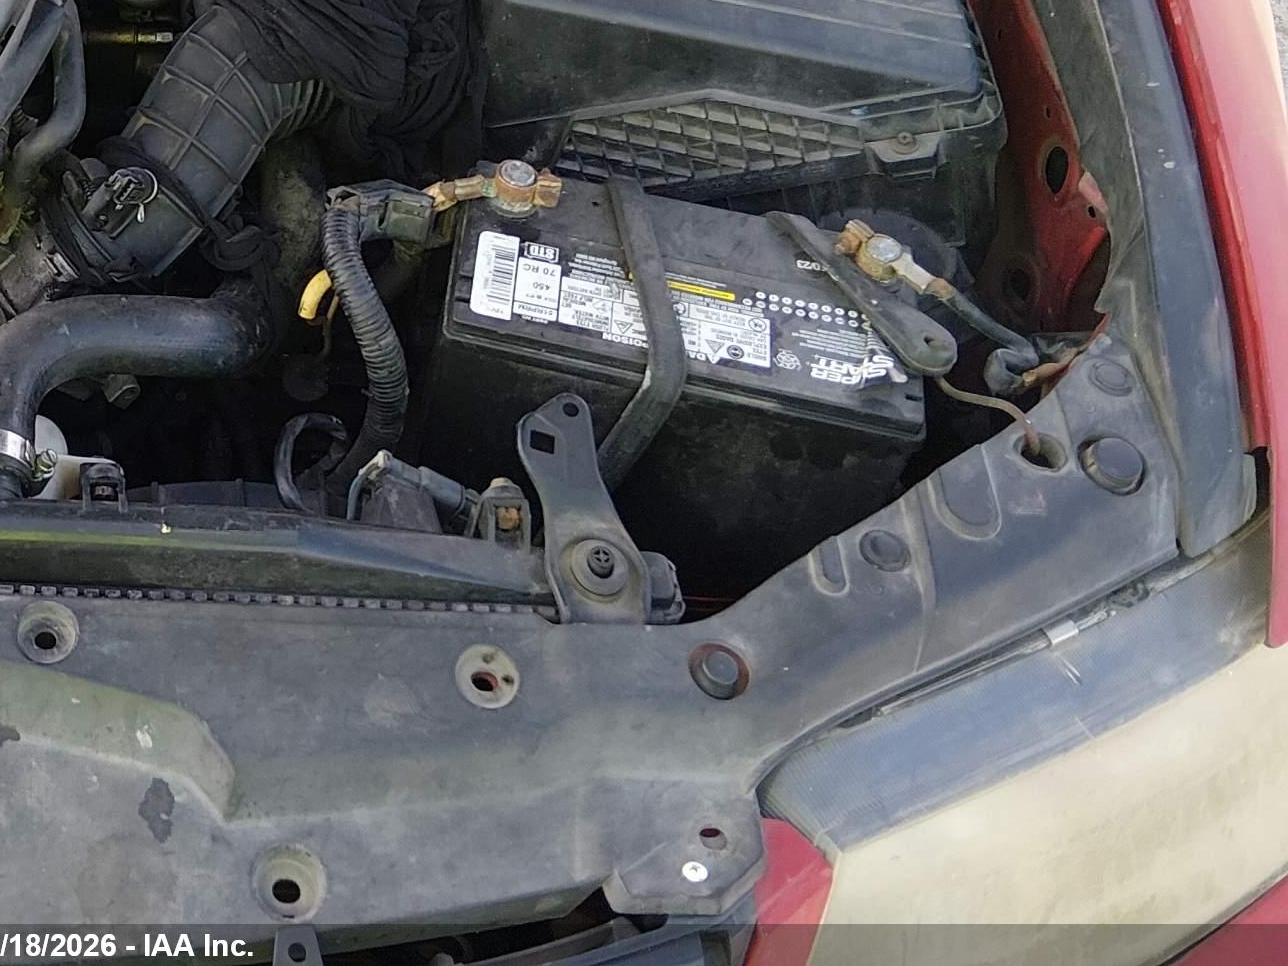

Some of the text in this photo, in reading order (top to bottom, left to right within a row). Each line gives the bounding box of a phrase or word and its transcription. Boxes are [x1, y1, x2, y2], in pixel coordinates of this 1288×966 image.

[523, 263, 556, 277] 70 RC
[532, 281, 550, 291] 450
[602, 332, 649, 349] POISON
